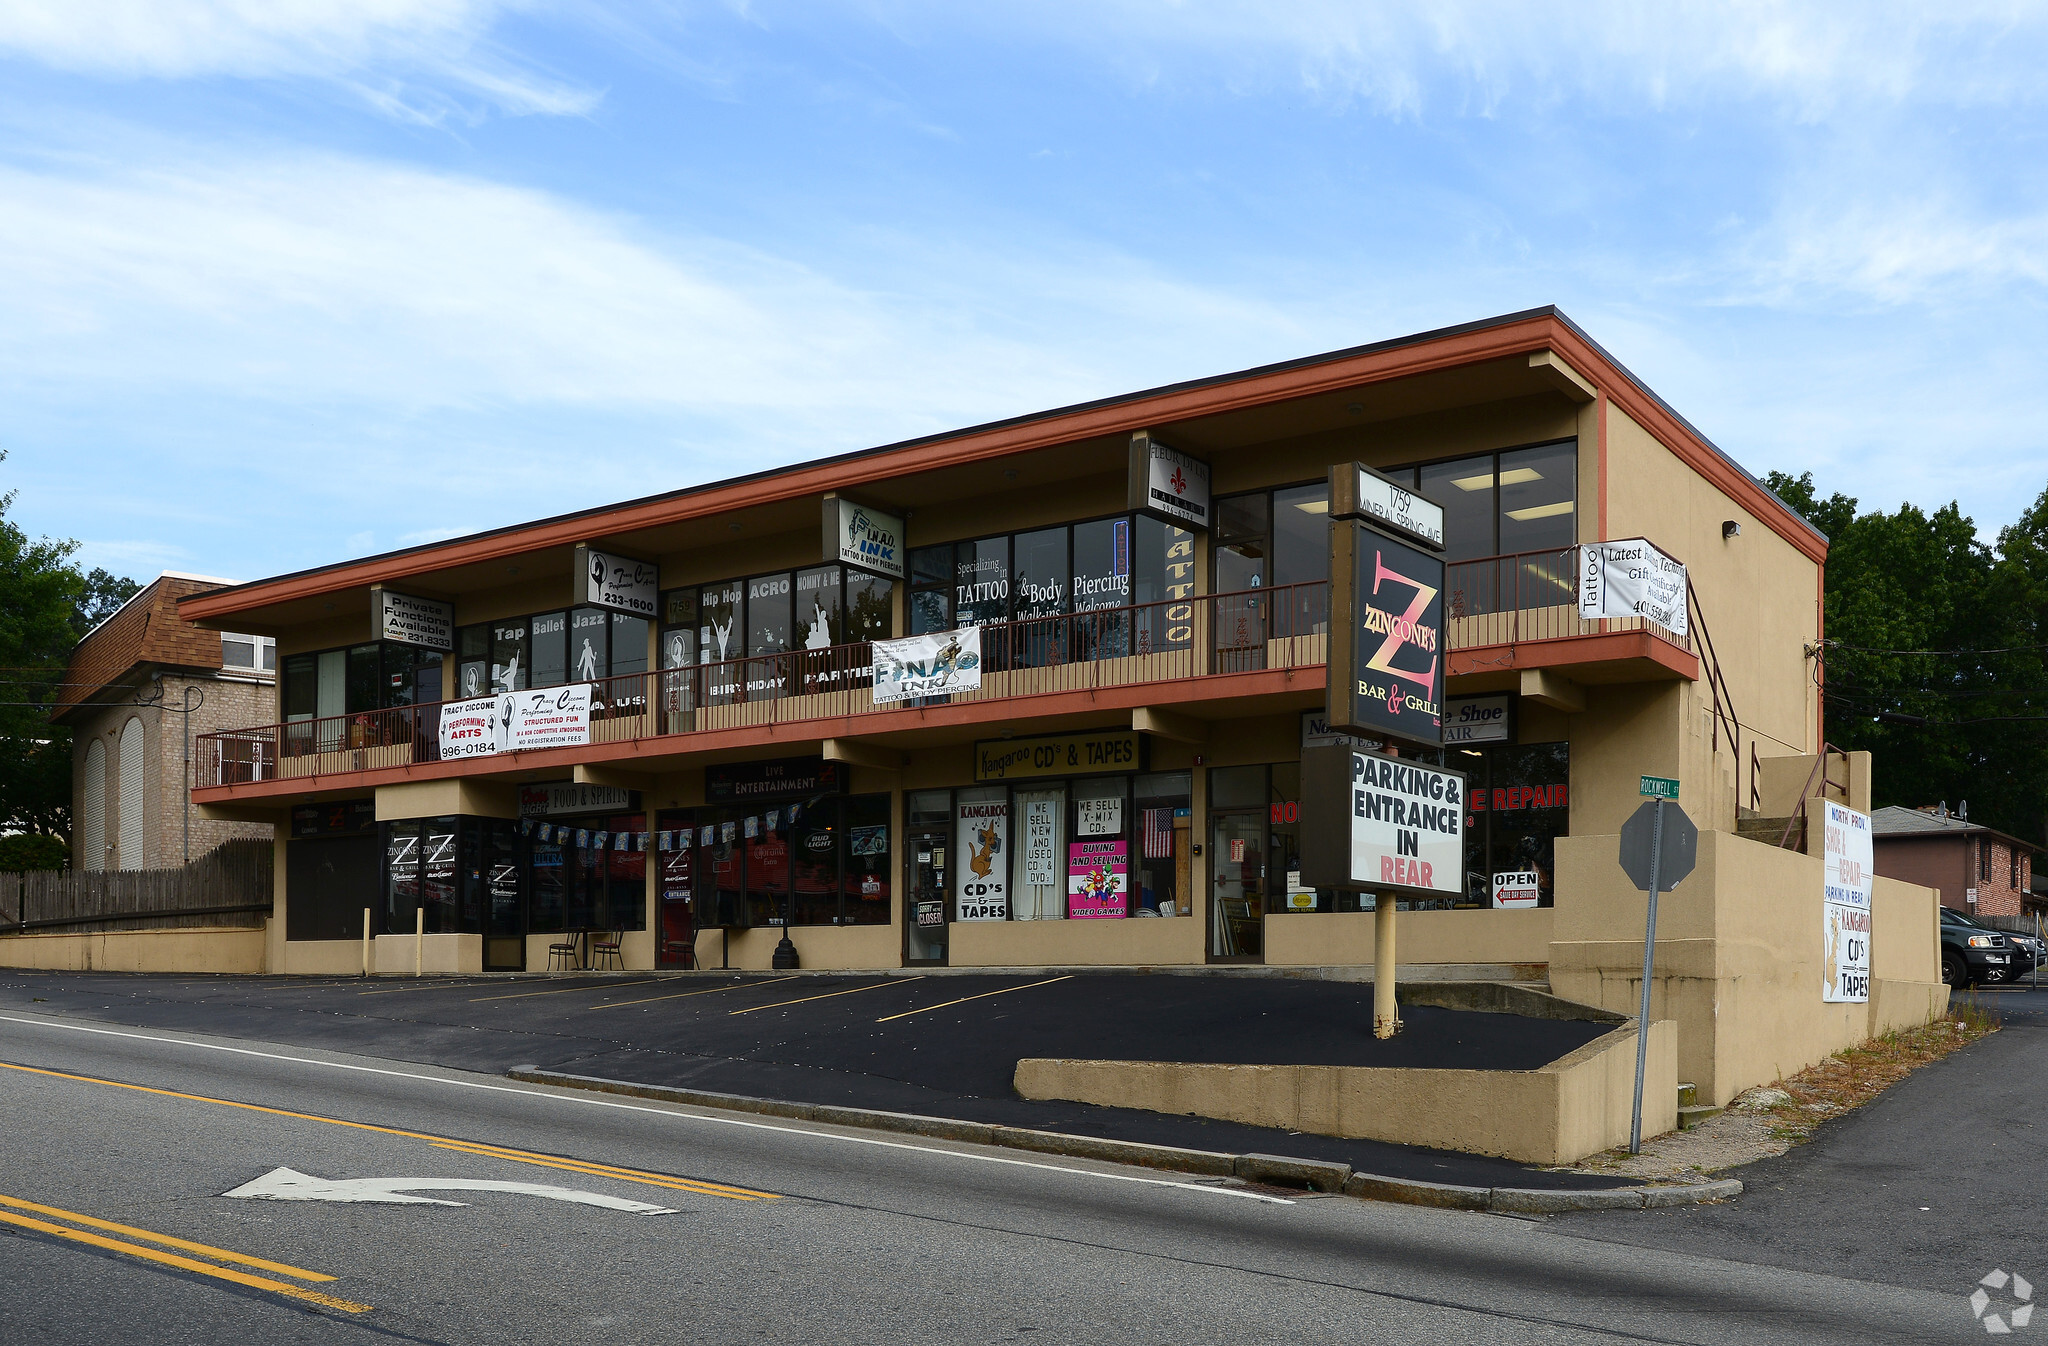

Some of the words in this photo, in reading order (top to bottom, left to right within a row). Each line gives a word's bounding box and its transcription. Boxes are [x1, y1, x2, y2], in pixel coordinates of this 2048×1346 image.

[1389, 485, 1411, 514] 1759
[1360, 496, 1393, 521] MINERAL
[1396, 512, 1424, 537] SPRING
[1427, 527, 1441, 542] AVE
[860, 539, 894, 560] INK
[1116, 523, 1126, 574] TATTOO
[1608, 546, 1642, 562] Latest
[841, 548, 860, 561] TATTOO
[861, 554, 865, 562] &
[866, 555, 879, 566] BODY
[880, 560, 902, 573] PIERCING
[957, 557, 1000, 578] Specializing
[999, 565, 1008, 578] in
[797, 573, 821, 592] MOMMY
[823, 572, 828, 587] &
[830, 570, 840, 586] ME
[1583, 550, 1599, 612] Tattoo
[1628, 567, 1649, 580] Gift
[749, 579, 790, 599] ACRO
[956, 579, 1009, 605] TATTOO
[1020, 577, 1030, 597] &
[1029, 577, 1062, 606] Body
[1073, 571, 1129, 596] Piercing
[391, 596, 442, 615] Private
[604, 592, 654, 612] 233-1600
[669, 600, 690, 613] 1759
[703, 593, 719, 607] Hip
[722, 589, 742, 604] Hop
[384, 606, 450, 627] Functions
[573, 614, 605, 629] Jazz
[389, 617, 446, 636] Available
[494, 627, 525, 641] Tap
[533, 618, 565, 635] Ballet
[1364, 603, 1437, 653] ZINCONE'S
[874, 693, 903, 703] TATTOO
[912, 689, 936, 698] BODY
[937, 683, 980, 694] PIERCING
[901, 677, 949, 693] INK
[531, 694, 554, 710] Tracy
[556, 689, 586, 710] Ciccone
[1357, 679, 1387, 701] BAR
[1387, 683, 1406, 715] &
[1405, 695, 1440, 717] GRILL
[444, 705, 464, 715] TRACY
[464, 701, 495, 712] CICCONE
[520, 708, 553, 718] Performing
[566, 704, 585, 713] Arts
[1459, 704, 1503, 722] Shoe
[448, 717, 486, 731] PERFORMING
[523, 715, 564, 727] STRUCTURED
[565, 715, 579, 723] FUN
[450, 728, 482, 740] ARTS
[533, 727, 558, 735] COMPETITIVE
[527, 736, 566, 745] REGISTRATION
[441, 742, 496, 758] 996-0184
[981, 747, 1030, 779] Kangaroo
[1067, 743, 1079, 766] &
[1086, 739, 1133, 765] TAPES
[735, 777, 816, 795] ENTERTAINMENT
[1640, 778, 1671, 795] ROCKWELL
[1674, 785, 1679, 793] ST
[553, 788, 577, 808] FOOD
[580, 786, 587, 806] &
[591, 785, 627, 805] SPIRITS
[1493, 784, 1569, 812] REPAIR
[960, 804, 1008, 819] KANGAROO
[1035, 803, 1047, 813] WE
[1079, 802, 1092, 811] WE
[1096, 800, 1119, 810] SELL
[1354, 788, 1458, 836] ENTRANCE
[1030, 815, 1051, 825] SELL
[1084, 811, 1113, 822] X-MIX
[1831, 807, 1849, 825] NORTH
[1851, 814, 1866, 831] PROV.
[1031, 826, 1051, 836] NEW
[1089, 823, 1106, 833] CDs
[808, 840, 833, 848] LIGHT
[811, 834, 829, 842] BUD
[1033, 838, 1049, 848] AND
[1397, 828, 1418, 857] IN
[1825, 825, 1841, 855] SHOE
[1028, 849, 1052, 859] USED
[1082, 843, 1115, 854] BUYING
[1047, 861, 1052, 870] &
[1071, 856, 1090, 866] AND
[1092, 855, 1127, 865] SELLING
[1381, 855, 1434, 888] REAR
[1495, 873, 1537, 886] OPEN
[1839, 858, 1861, 887] REPAIR
[977, 896, 988, 905] &
[1520, 890, 1536, 898] SERVICE
[1825, 885, 1845, 901] PARKING
[1845, 887, 1850, 902] IN
[1851, 890, 1864, 904] REAR
[919, 912, 942, 925] CLOSED
[961, 905, 1006, 919] TAPES
[1072, 907, 1096, 916] VIDEO
[1097, 907, 1125, 915] GAMES
[1841, 908, 1870, 933] KANGAROO
[1842, 973, 1868, 997] TAPES
